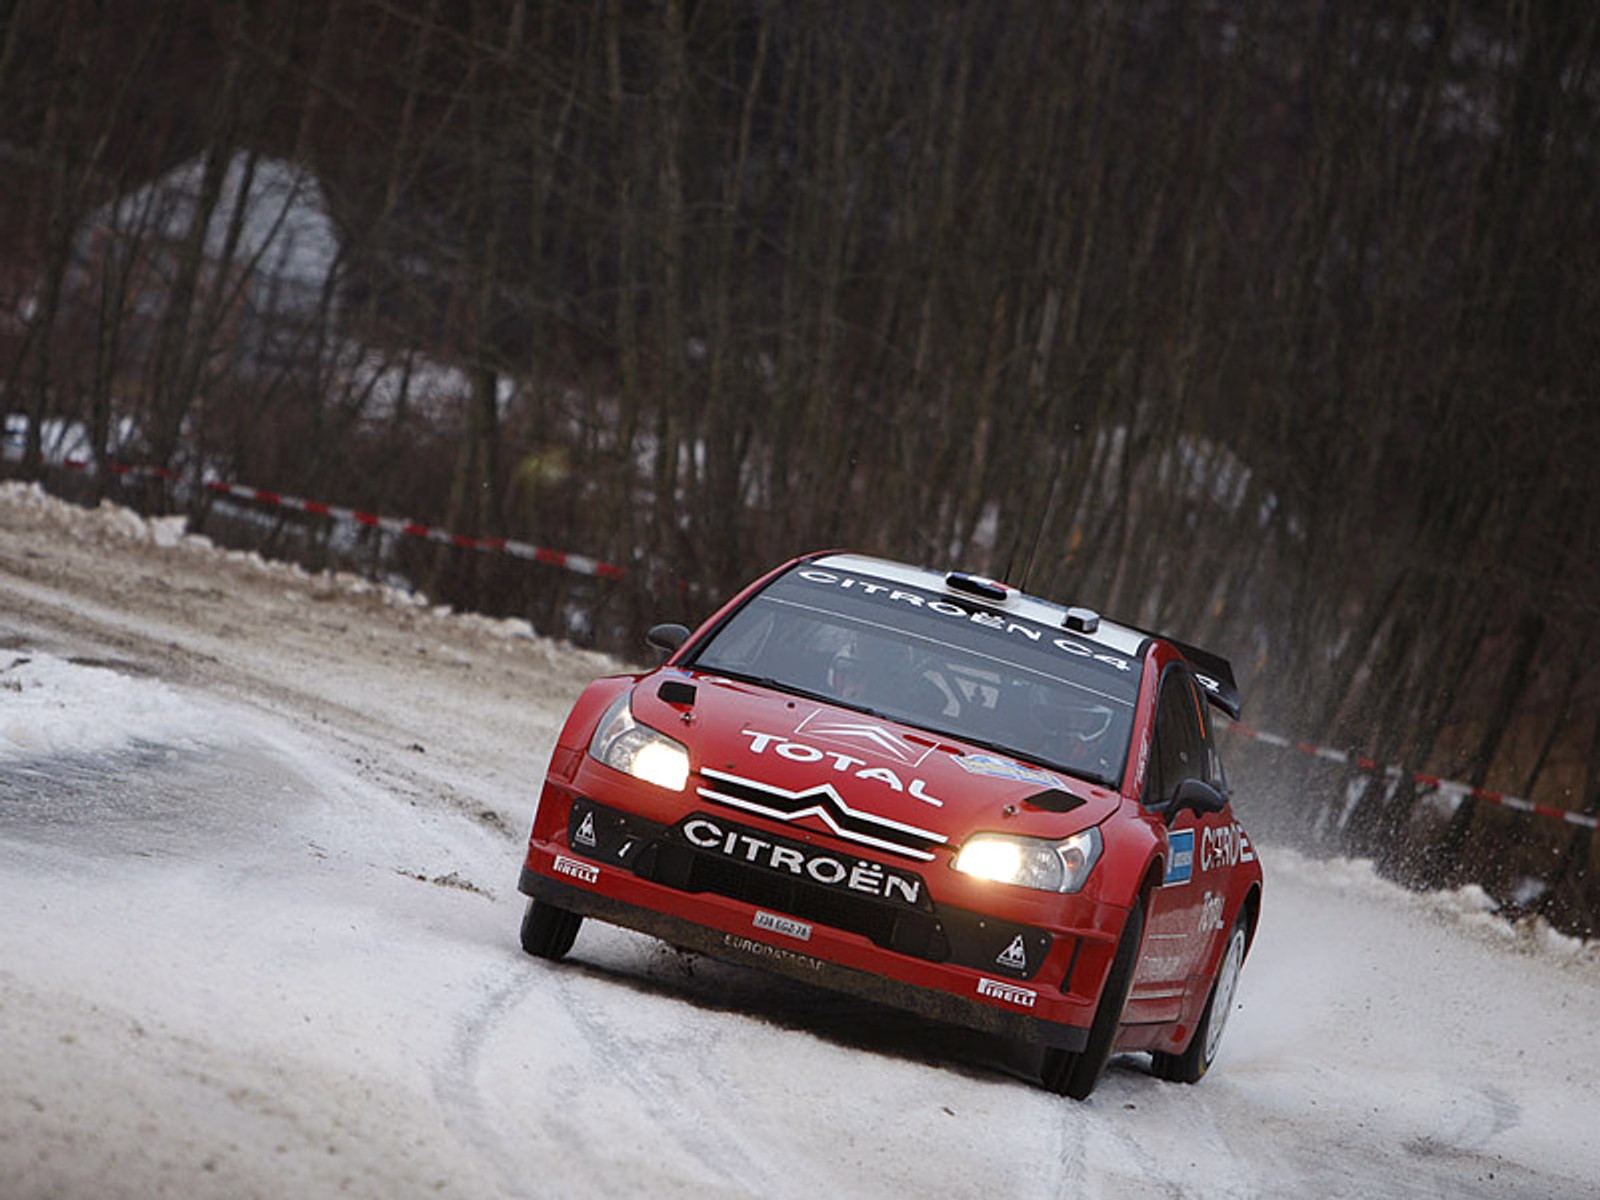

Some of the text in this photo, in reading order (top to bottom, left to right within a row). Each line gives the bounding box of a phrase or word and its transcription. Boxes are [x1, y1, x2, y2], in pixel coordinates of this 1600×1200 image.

[798, 570, 1132, 672] CITROËN C4
[742, 729, 944, 808] TOTAL
[552, 855, 600, 884] PIRELLI
[683, 819, 920, 903] CITROËN
[977, 977, 1038, 1008] PIRELLI
